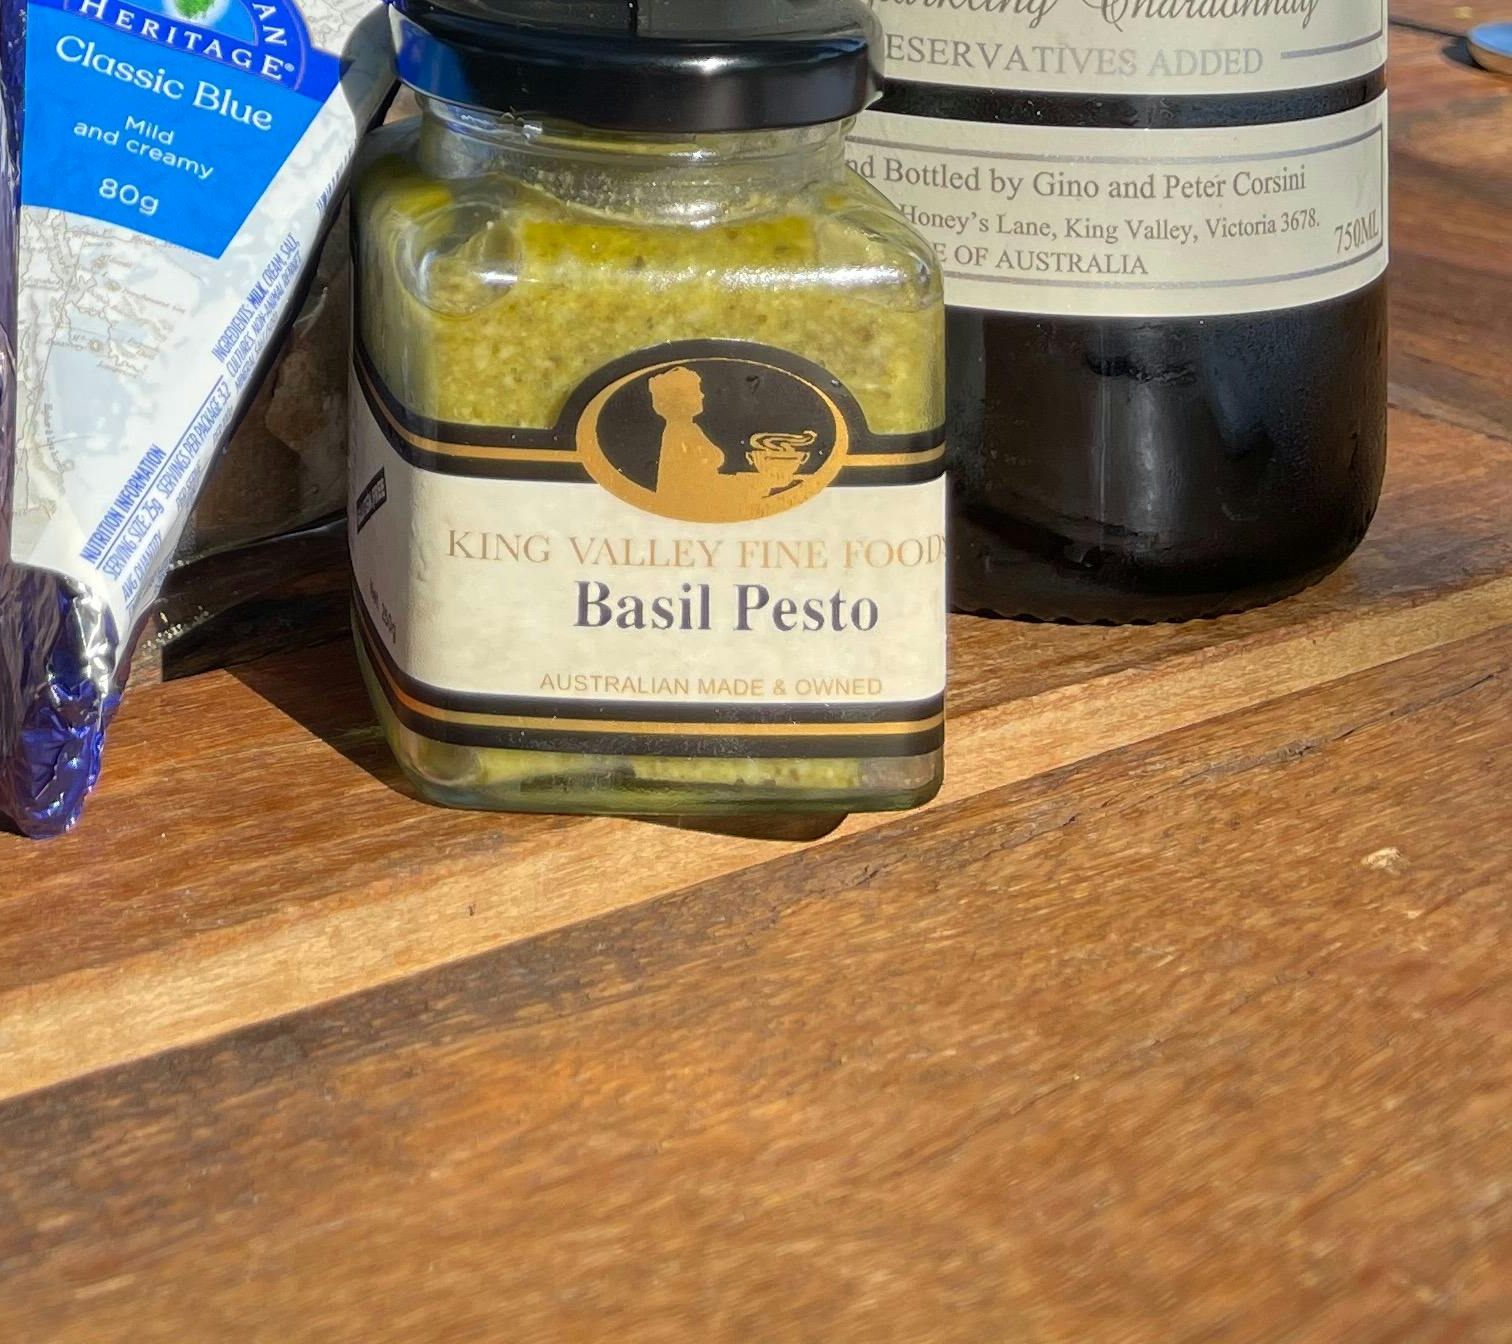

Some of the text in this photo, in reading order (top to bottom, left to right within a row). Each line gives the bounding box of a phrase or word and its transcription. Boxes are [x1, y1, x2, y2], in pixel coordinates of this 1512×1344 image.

[886, 33, 1264, 76] ESERVATIVES ADDED
[55, 33, 274, 132] Classic Blue
[73, 119, 215, 181] and creamy
[125, 116, 176, 146] Mild
[98, 177, 160, 216] 80g
[846, 155, 1307, 200] nd Bottled by Gino and Peter Corsini
[899, 203, 1321, 245] Honey's Lane, King Valley, Victoria 3678.
[1334, 208, 1380, 254] 750ML
[954, 244, 990, 266] OF
[995, 250, 1149, 275] AUSTRALIA
[155, 448, 192, 499] SERVINGS
[181, 431, 202, 458] PER
[78, 442, 167, 565] NUTRITION INFORMATION
[101, 534, 139, 581] SERVING
[448, 529, 550, 564] KING
[568, 537, 721, 567] VALLEY
[737, 540, 828, 569] FINE
[574, 581, 879, 632] Basil Pesto
[540, 674, 882, 697] AUSTRALIAN MADE & OWNED
